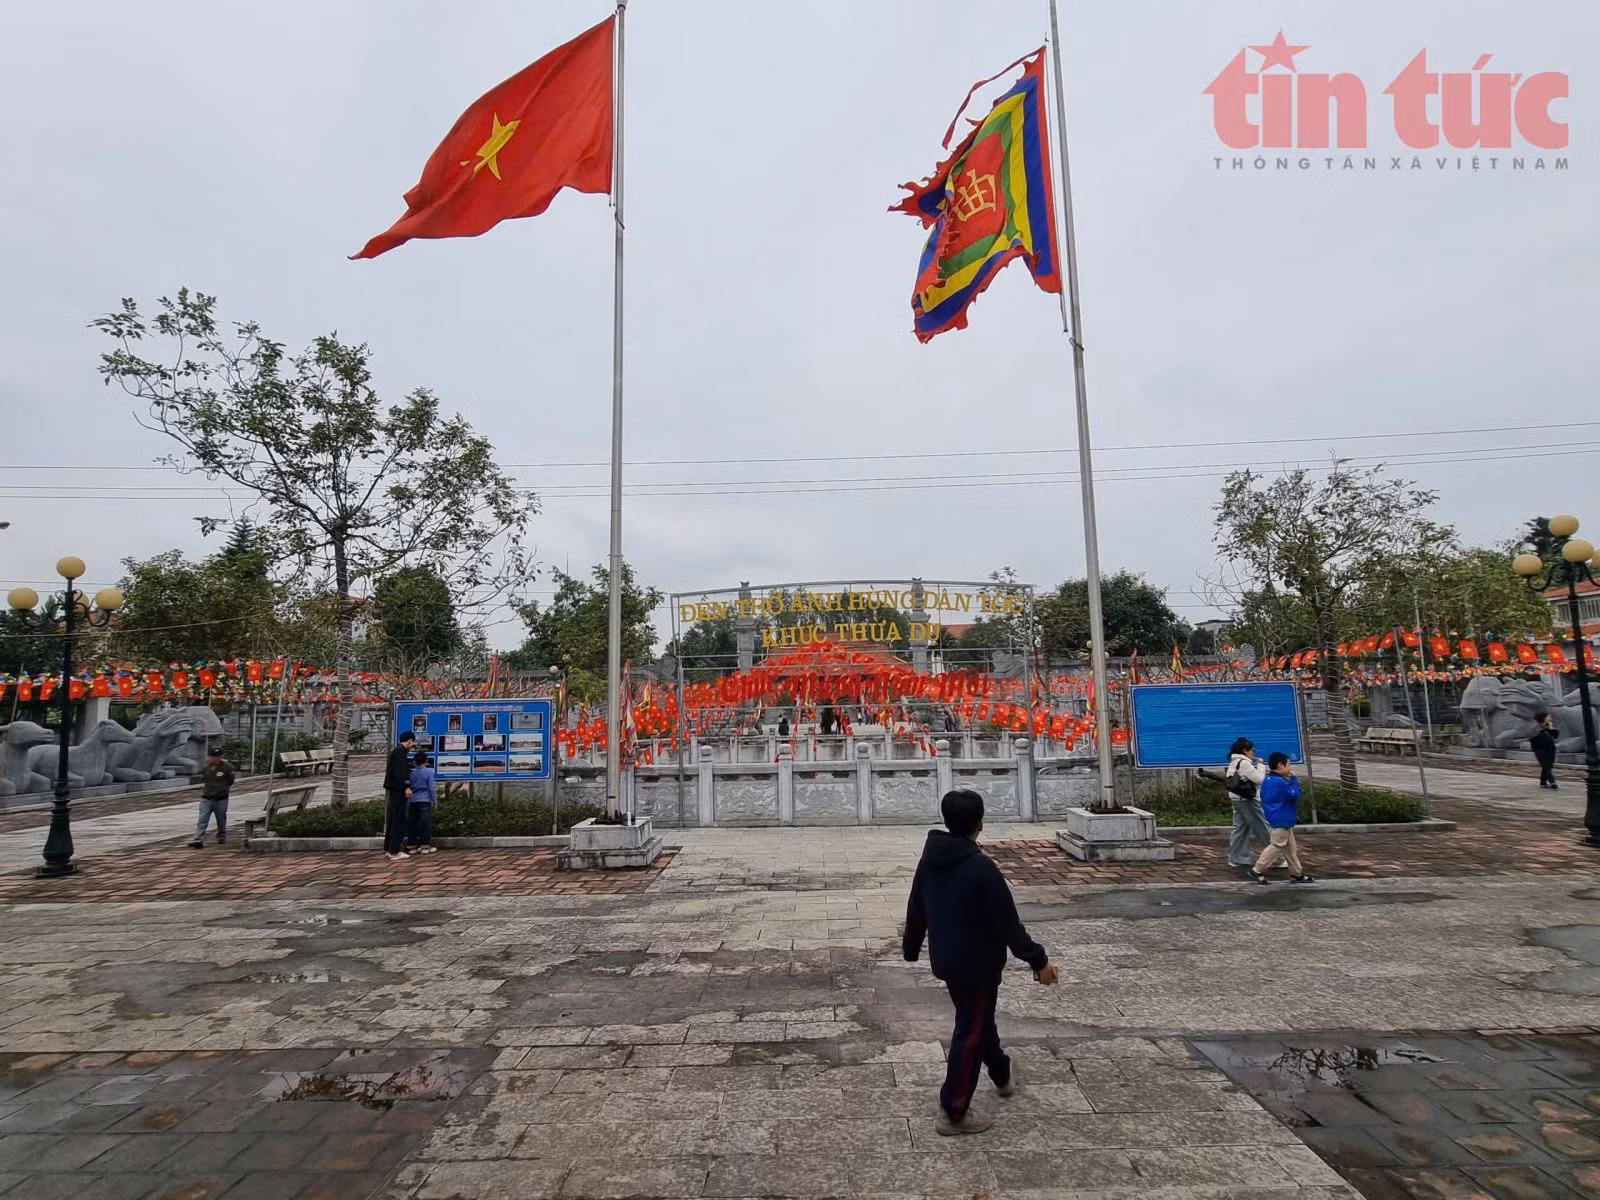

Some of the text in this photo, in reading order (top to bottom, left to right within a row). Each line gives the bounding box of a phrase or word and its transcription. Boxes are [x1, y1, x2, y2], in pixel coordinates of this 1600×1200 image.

[680, 593, 729, 623] ĐỀN
[789, 591, 843, 612] ANH
[846, 585, 914, 611] HÙNG
[923, 588, 973, 613] DÂN
[760, 618, 828, 648] KHÚC
[834, 615, 903, 642] THỪA
